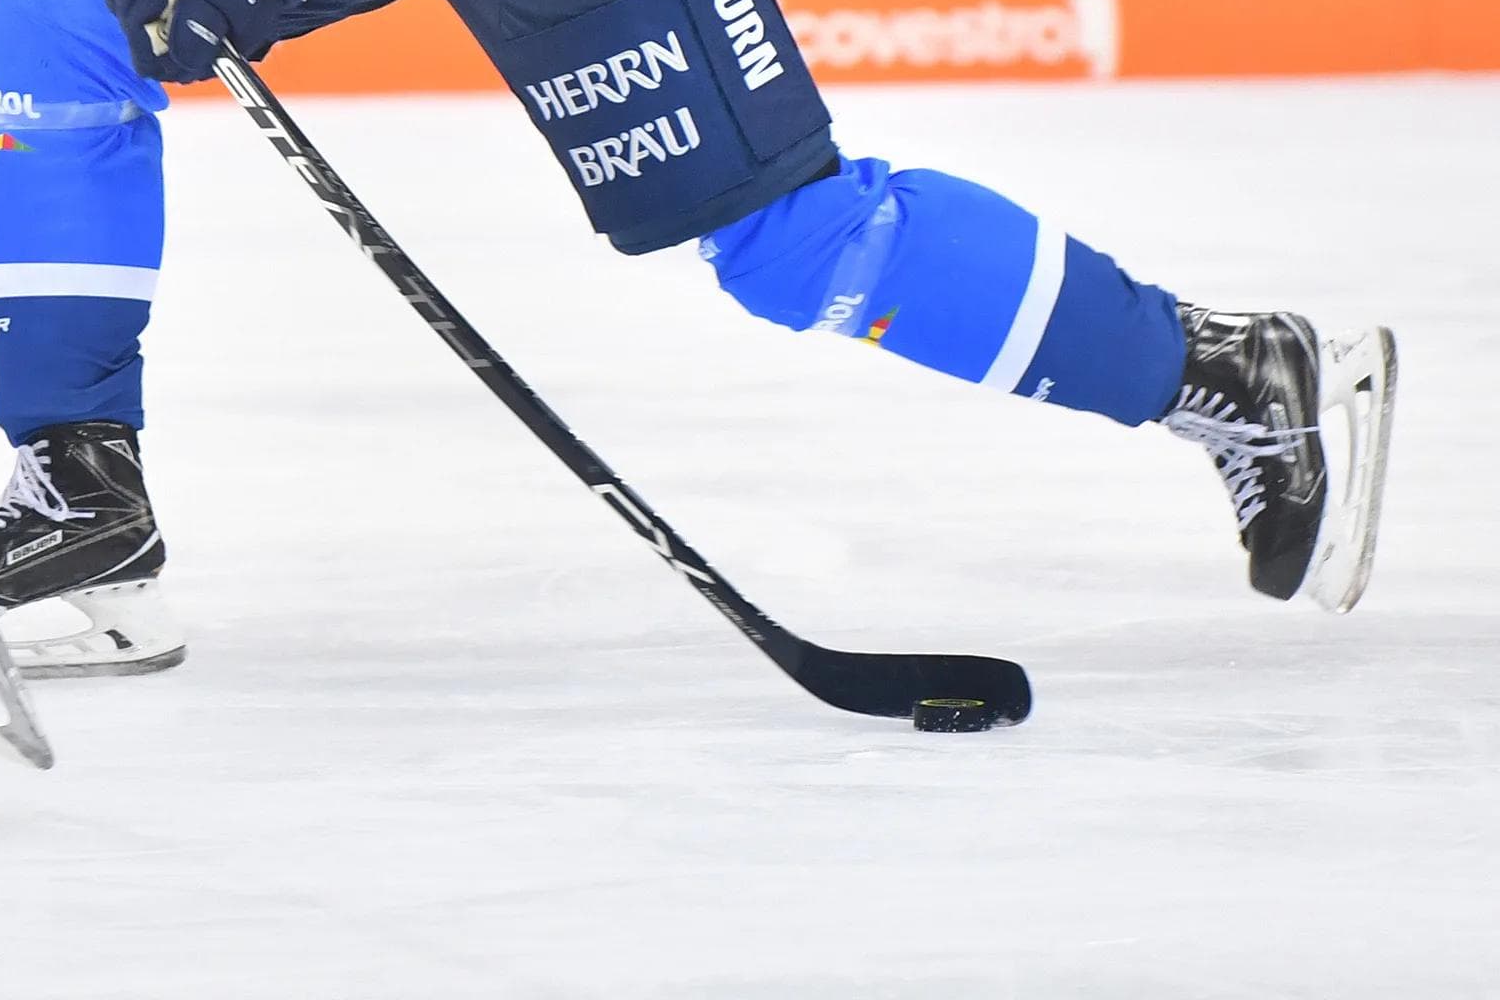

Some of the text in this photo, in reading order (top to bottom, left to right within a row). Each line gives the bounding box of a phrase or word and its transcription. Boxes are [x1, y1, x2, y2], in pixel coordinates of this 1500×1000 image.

[526, 30, 690, 122] HERRN
[568, 106, 701, 187] BRÄU
[11, 534, 59, 562] BAUER
